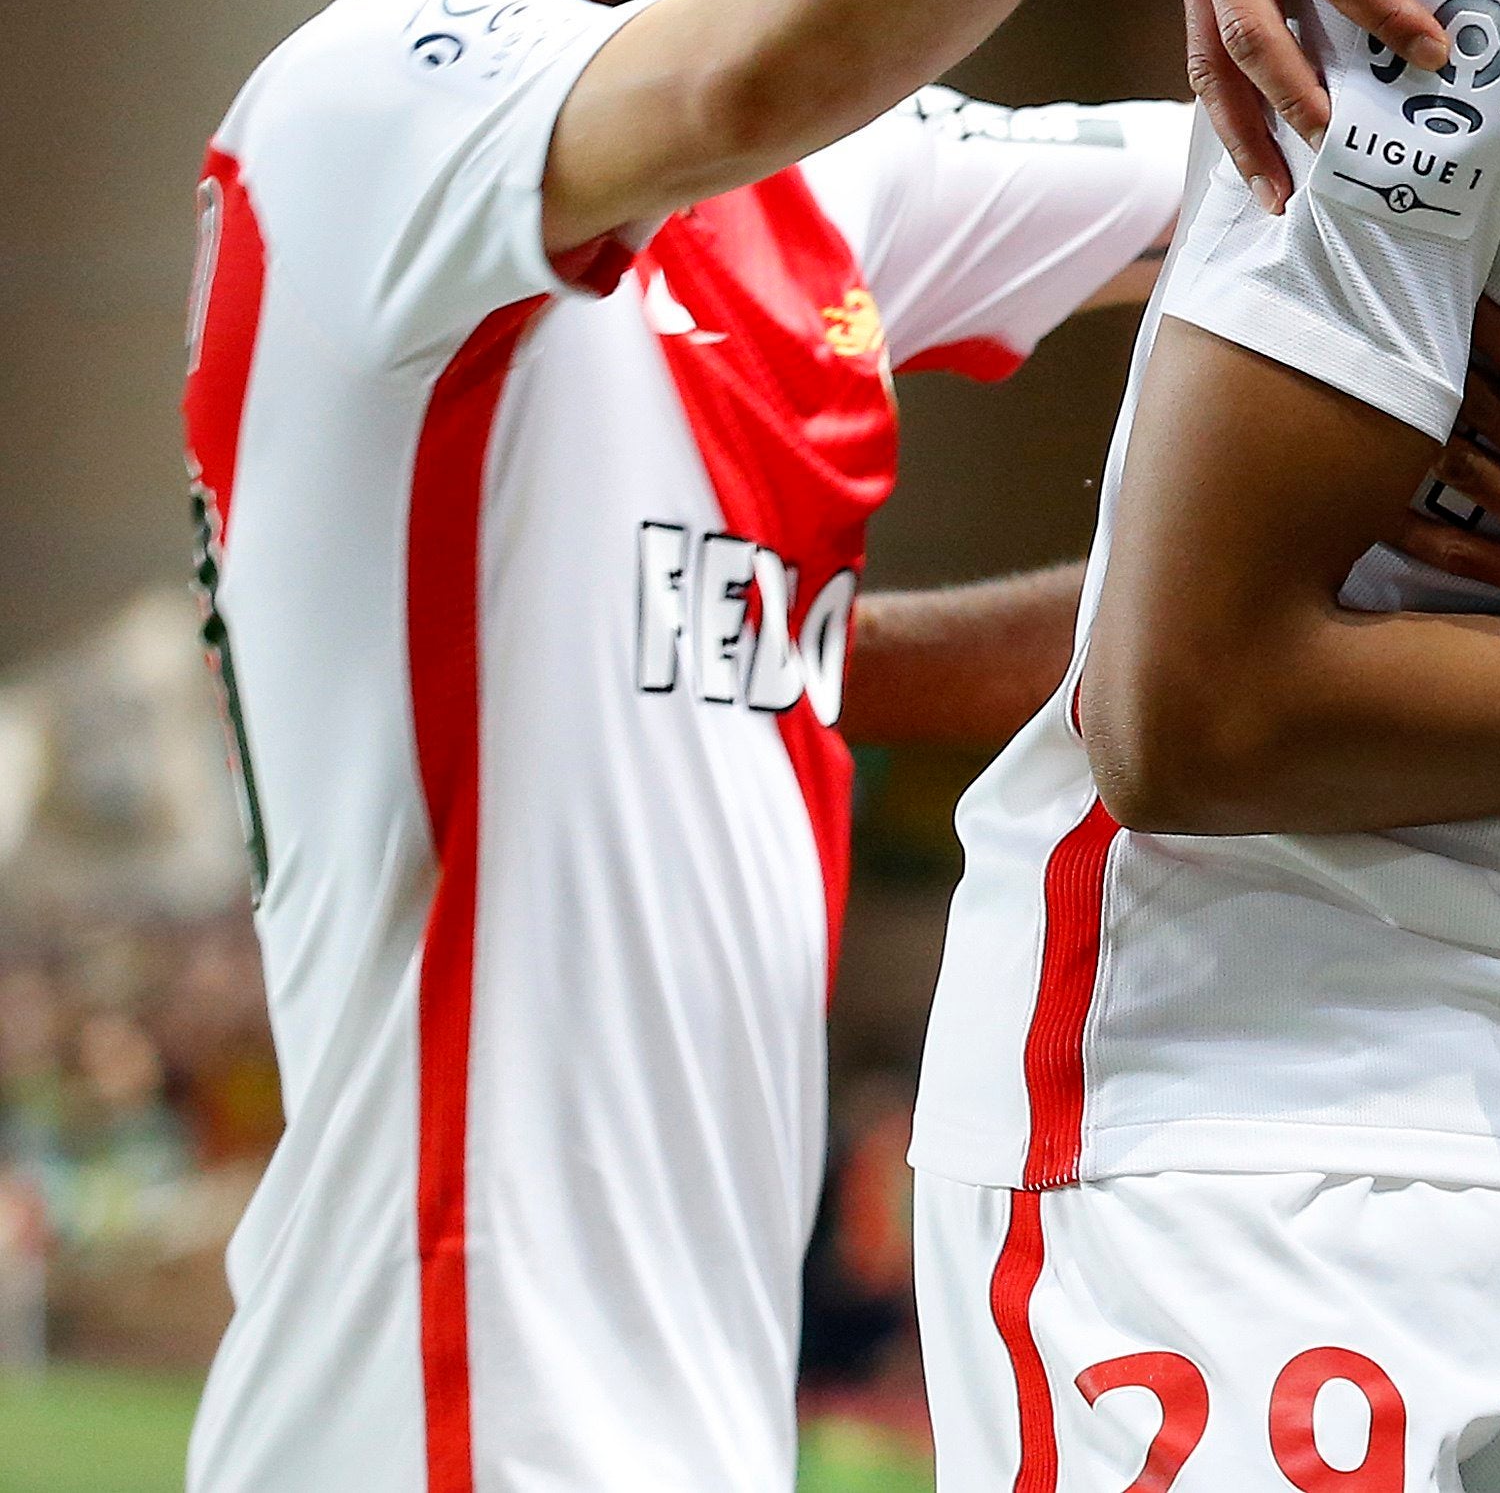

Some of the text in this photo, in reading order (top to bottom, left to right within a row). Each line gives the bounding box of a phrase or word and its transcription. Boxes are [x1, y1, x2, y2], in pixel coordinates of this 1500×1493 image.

[1344, 125, 1483, 190] LIGUE 1
[1073, 1346, 1407, 1493] 29
